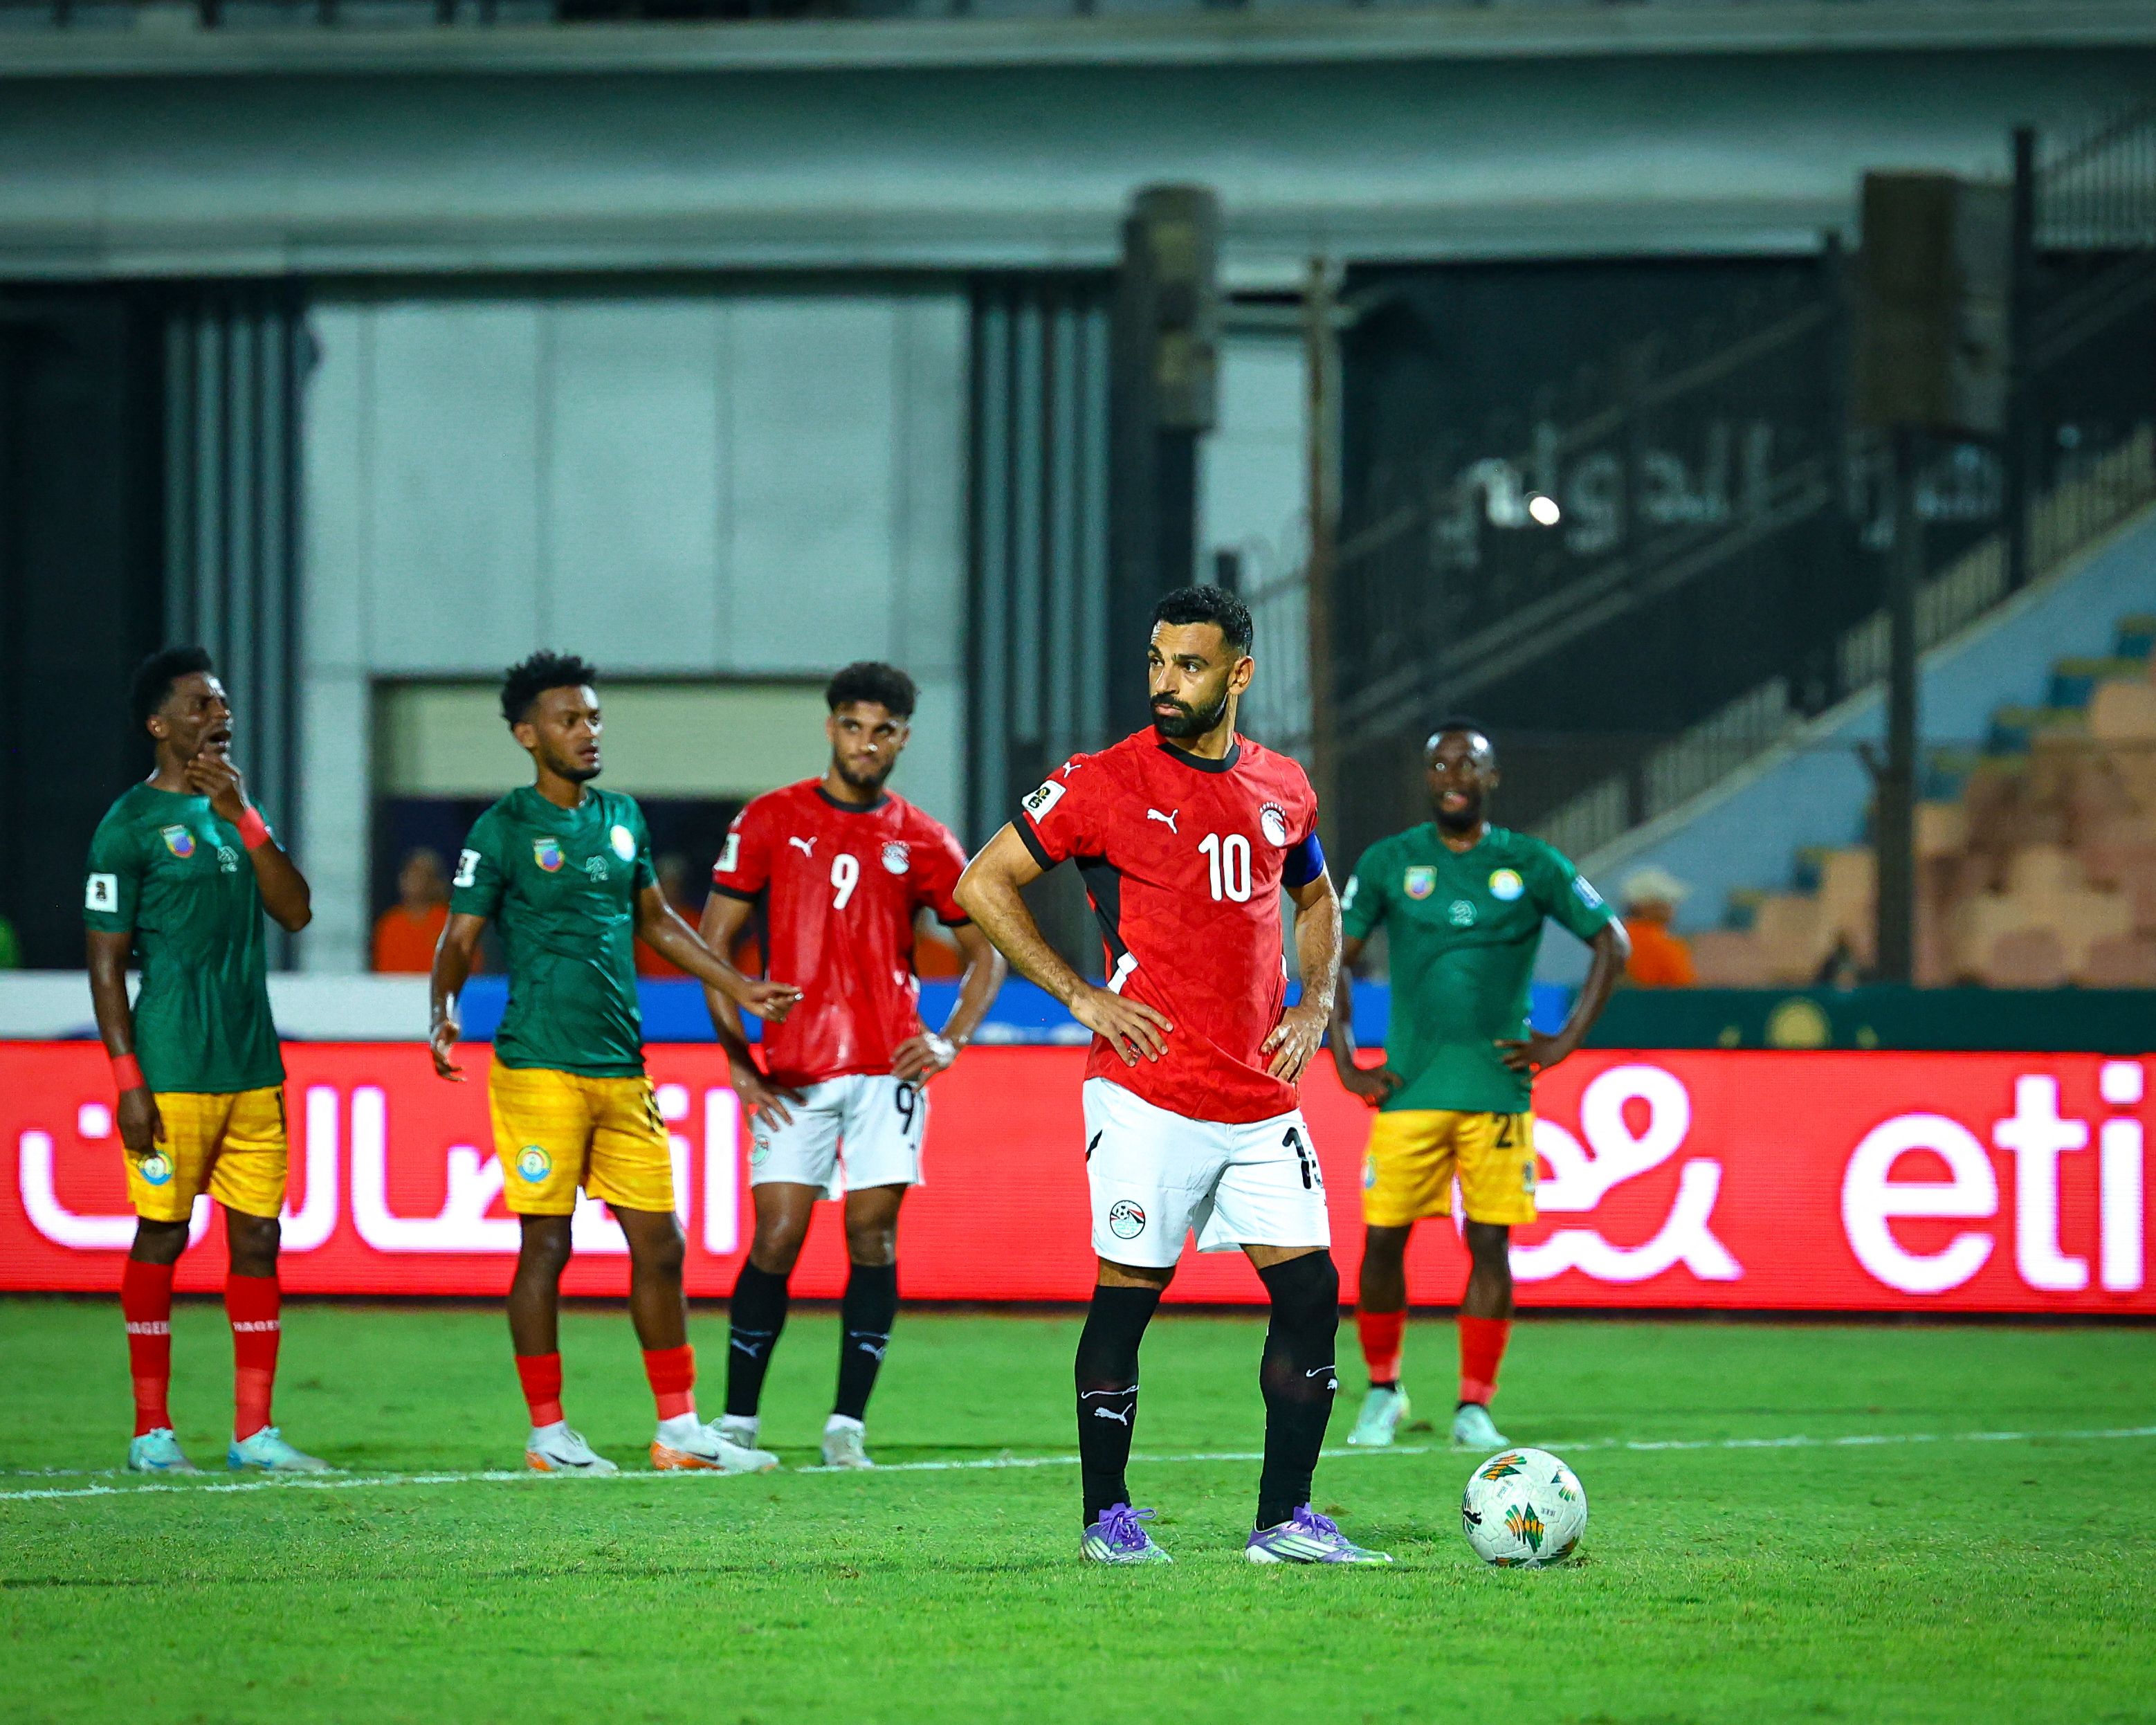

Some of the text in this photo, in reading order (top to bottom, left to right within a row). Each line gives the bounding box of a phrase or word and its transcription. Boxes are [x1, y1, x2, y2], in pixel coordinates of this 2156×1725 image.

[830, 853, 860, 910] 9
[1197, 832, 1252, 902] 10
[896, 1083, 915, 1135] 9
[19, 1084, 741, 1255] اتصالت
[1840, 1060, 2144, 1295] eti
